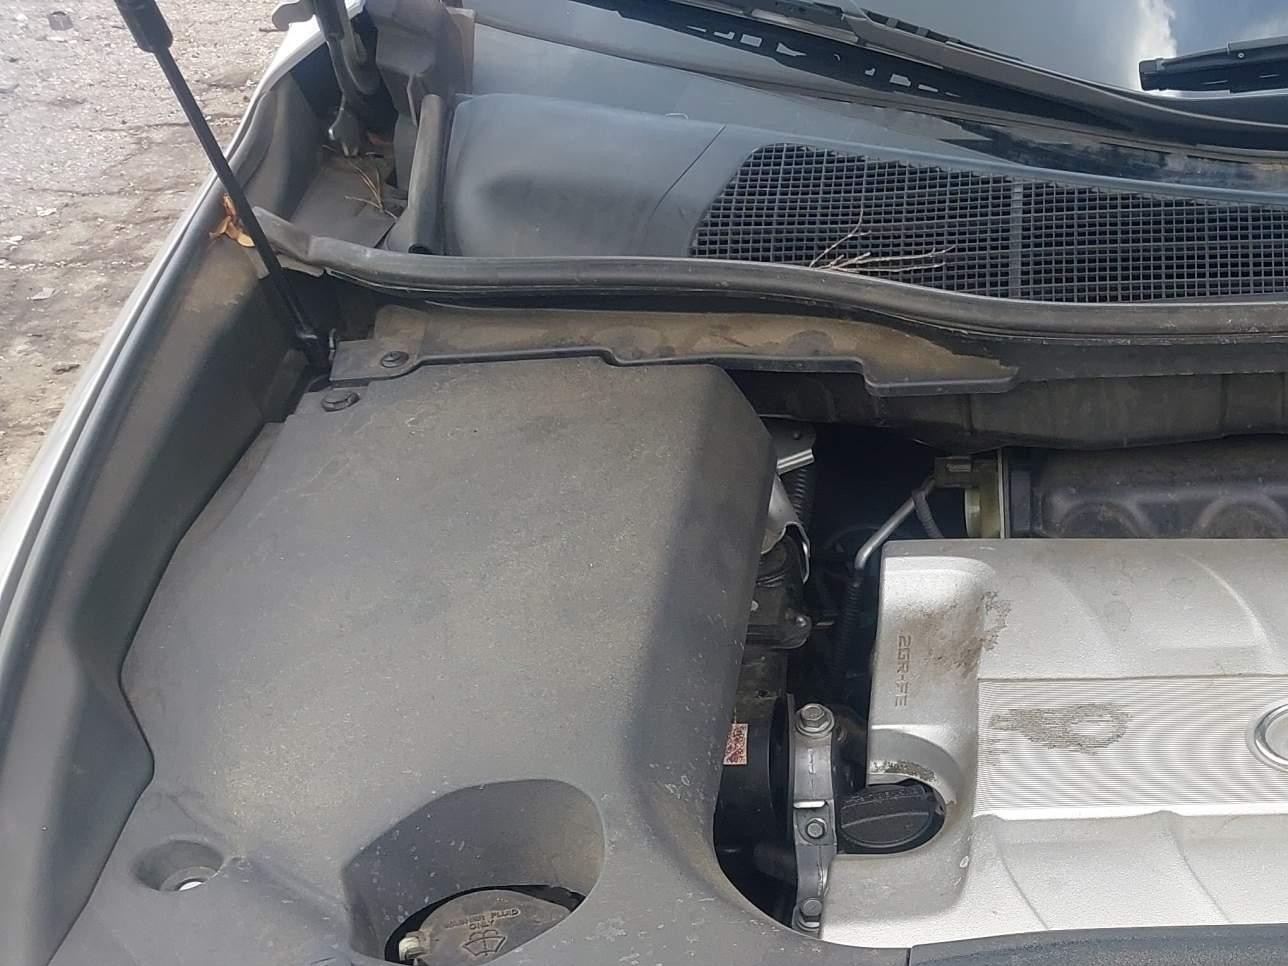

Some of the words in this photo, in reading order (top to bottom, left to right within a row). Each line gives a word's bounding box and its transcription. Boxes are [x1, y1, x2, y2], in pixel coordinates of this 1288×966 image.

[894, 634, 911, 707] 2GR-FE
[491, 908, 520, 919] FLUID
[469, 919, 495, 930] ONLY
